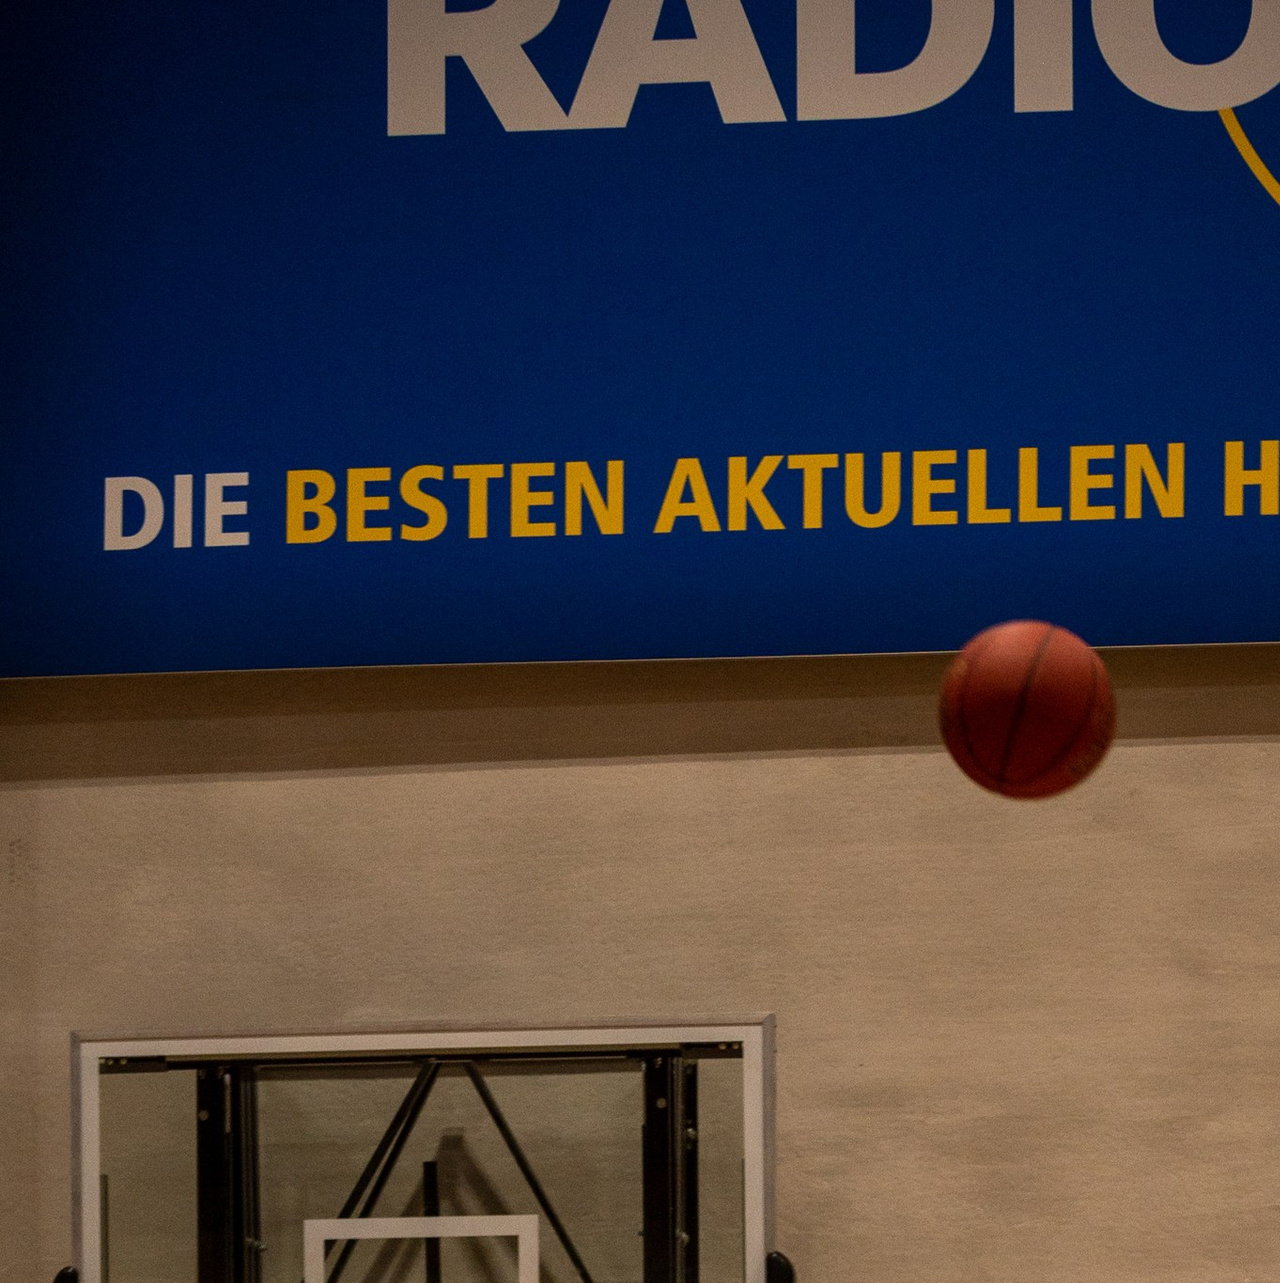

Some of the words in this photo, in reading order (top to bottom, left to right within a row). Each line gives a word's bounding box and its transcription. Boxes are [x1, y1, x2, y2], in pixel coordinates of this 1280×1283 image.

[104, 472, 249, 550] DIE
[286, 460, 624, 543] BESTEN
[654, 443, 1184, 533] AKTUELLEN
